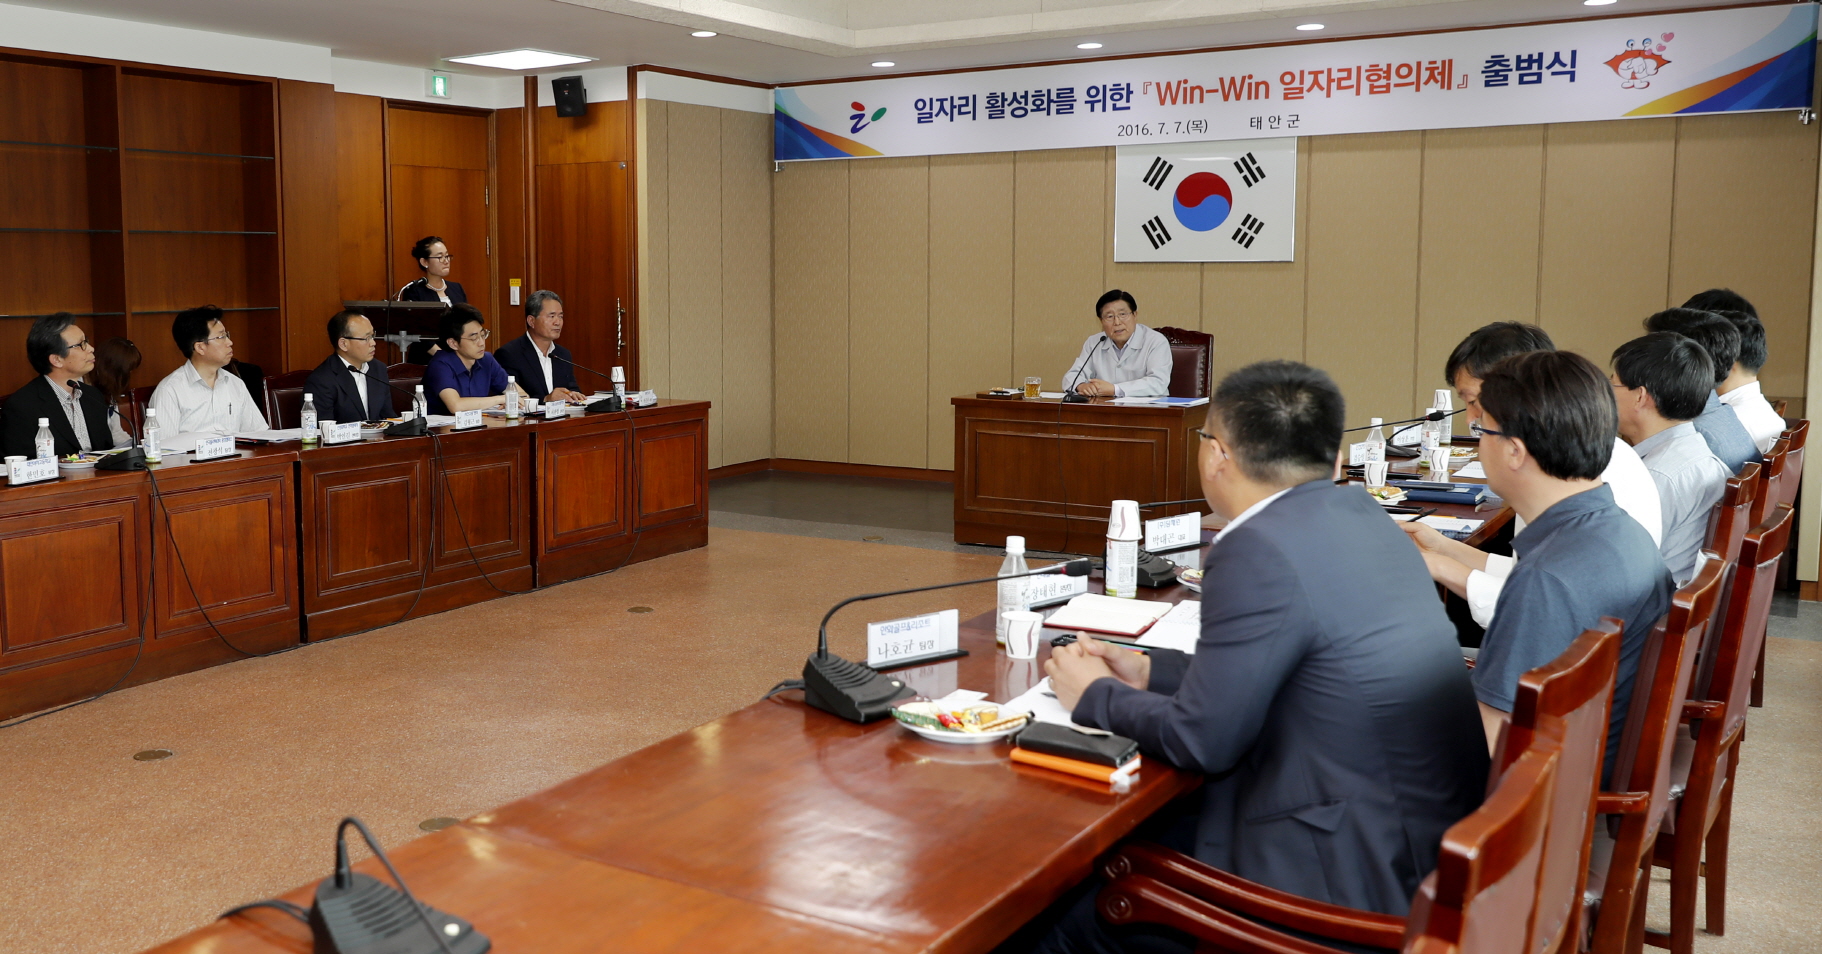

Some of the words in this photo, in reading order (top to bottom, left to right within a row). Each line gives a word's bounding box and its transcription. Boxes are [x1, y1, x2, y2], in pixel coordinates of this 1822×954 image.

[914, 94, 977, 124] 일자리
[985, 87, 1077, 120] 활성화를
[1084, 82, 1134, 113] 위한
[1481, 49, 1577, 88] 출범식
[1117, 123, 1153, 138] 2016.
